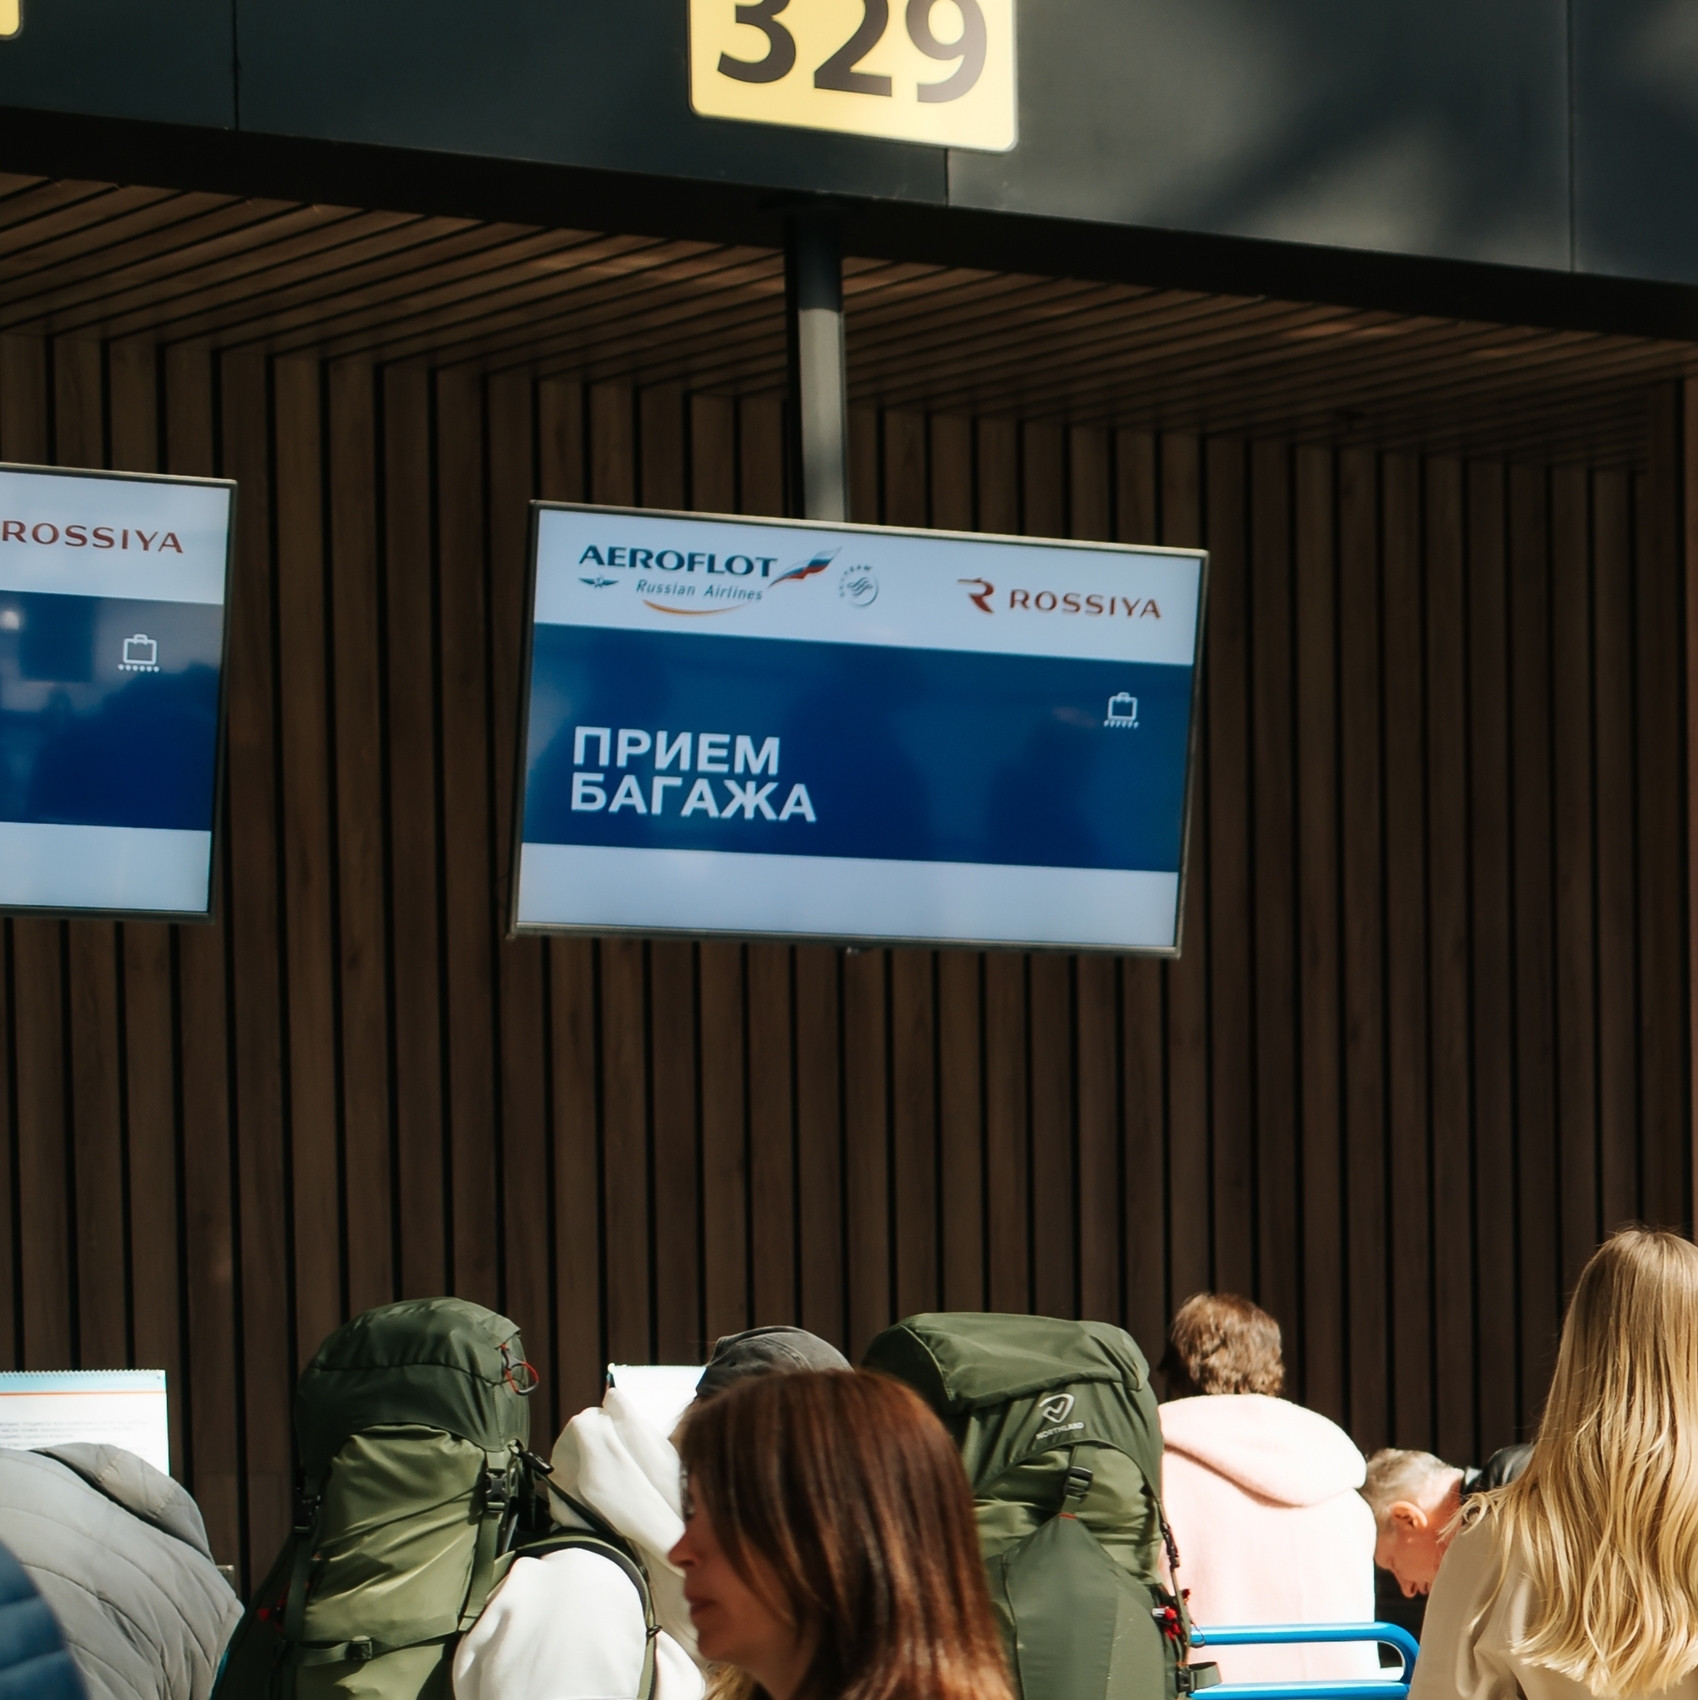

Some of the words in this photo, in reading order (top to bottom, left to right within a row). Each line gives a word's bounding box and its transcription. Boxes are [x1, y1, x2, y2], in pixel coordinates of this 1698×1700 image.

[716, 0, 988, 104] 329
[1, 520, 184, 554] ROSSIYA
[578, 544, 779, 577] AEROFLOT
[635, 579, 696, 598] Russian
[704, 582, 764, 601] Airlines
[1009, 588, 1162, 620] ROSSIYA
[573, 725, 780, 776] ПРИЕМ
[570, 772, 817, 823] БАГАЖА
